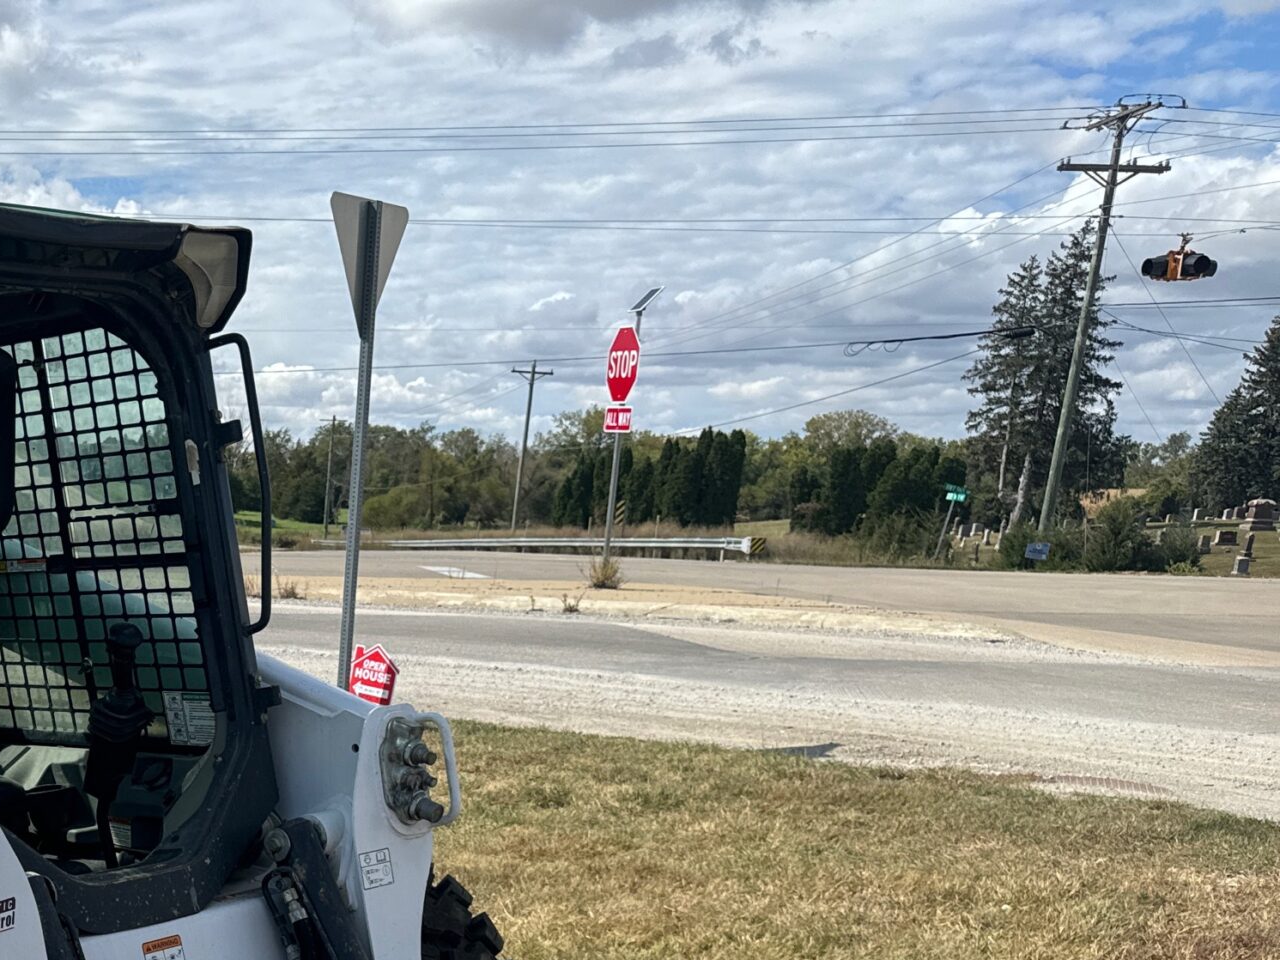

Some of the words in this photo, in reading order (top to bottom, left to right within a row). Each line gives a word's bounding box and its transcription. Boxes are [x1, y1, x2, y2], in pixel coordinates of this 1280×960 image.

[608, 350, 638, 379] STOP
[606, 412, 618, 427] ALL
[618, 412, 631, 427] WAY
[363, 659, 387, 671] OPEN
[354, 667, 391, 684] HOUSE
[151, 938, 179, 950] WARNING
